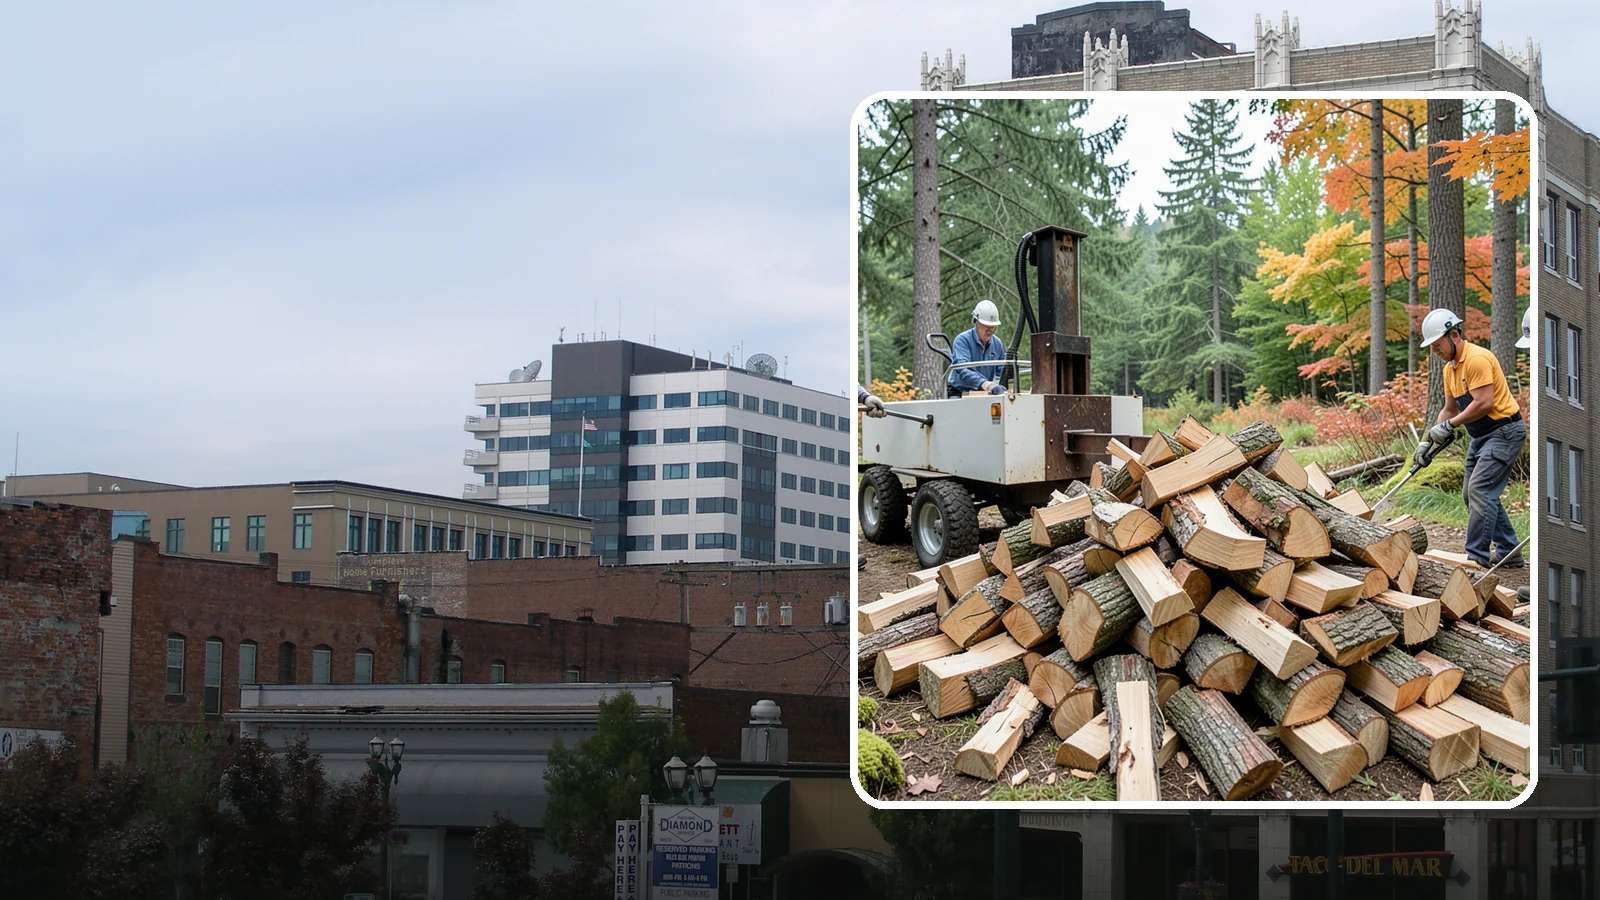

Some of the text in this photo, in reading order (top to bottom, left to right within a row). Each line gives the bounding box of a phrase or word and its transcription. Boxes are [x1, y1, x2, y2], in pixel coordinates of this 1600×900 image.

[370, 566, 427, 577] Furnishers
[660, 818, 713, 833] DIAMOND
[1022, 815, 1070, 828] BUILDING
[617, 825, 625, 852] PAY
[628, 825, 637, 852] PAY
[656, 845, 716, 854] RESERVED PARKING
[721, 852, 739, 863] Soup
[671, 862, 701, 870] PATRONS
[1346, 856, 1385, 875] DEL
[1392, 857, 1442, 877] MAR
[617, 856, 625, 893] HERE
[628, 856, 636, 893] HERE
[660, 889, 710, 898] PUBLIC PARKING
